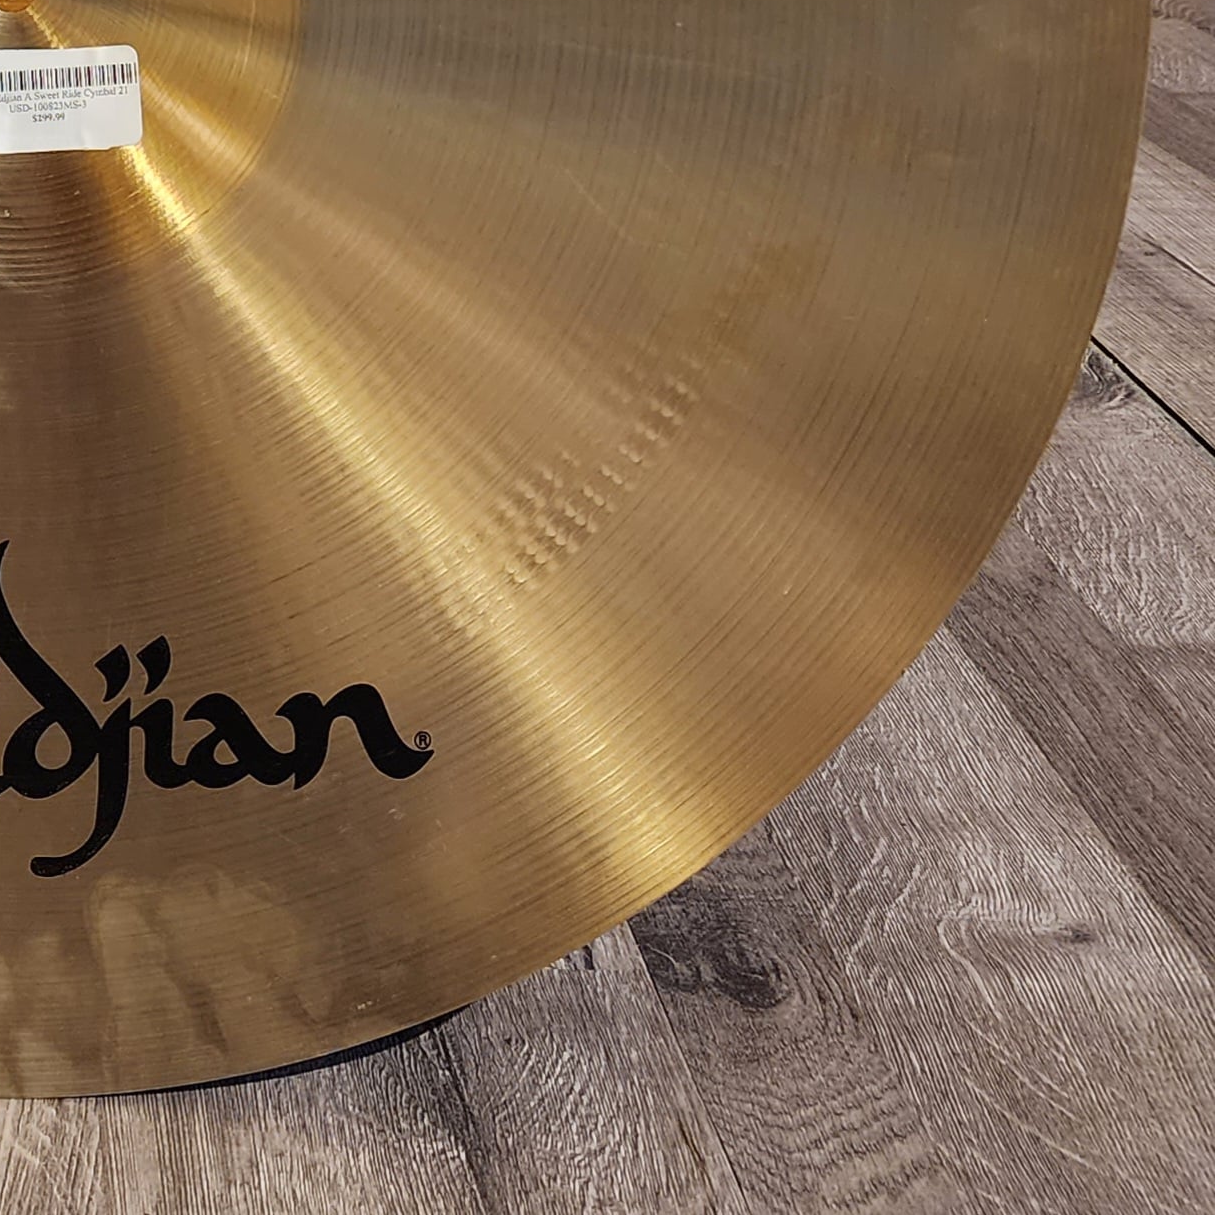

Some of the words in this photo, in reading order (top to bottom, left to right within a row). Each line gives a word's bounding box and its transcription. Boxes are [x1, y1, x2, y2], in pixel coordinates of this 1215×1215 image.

[24, 93, 32, 101] A
[34, 91, 60, 100] Sweet
[62, 89, 82, 99] Ride
[84, 87, 116, 98] Cymbal
[118, 86, 128, 95] 21
